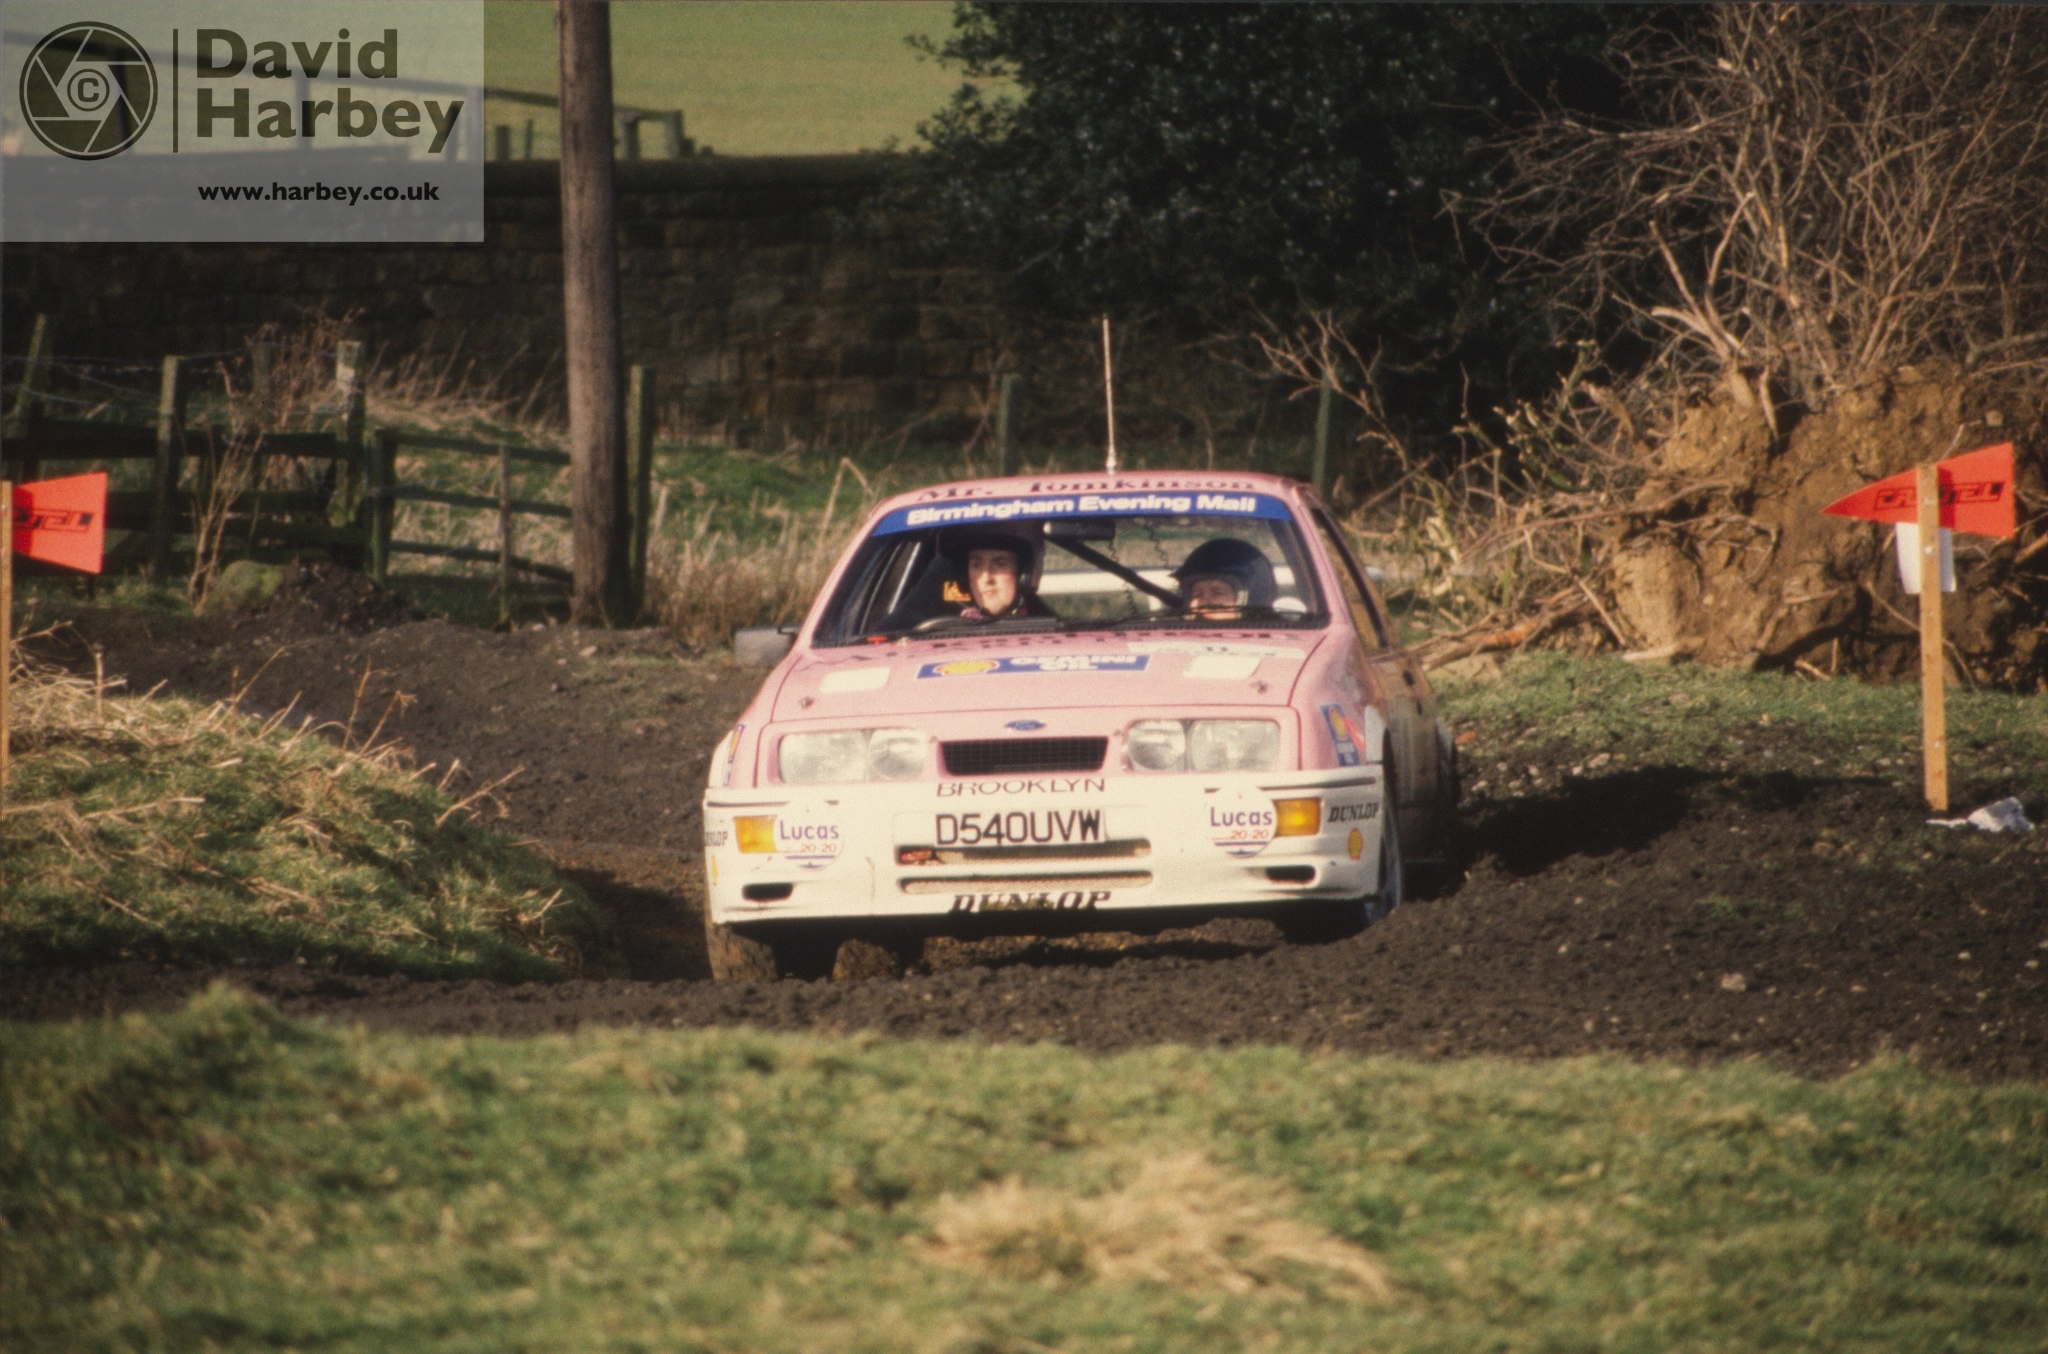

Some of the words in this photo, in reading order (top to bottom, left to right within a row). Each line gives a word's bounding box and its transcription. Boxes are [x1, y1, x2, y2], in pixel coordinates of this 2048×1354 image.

[1030, 480, 1255, 493] Tomkinson
[906, 498, 1075, 527] Birmingham
[1078, 494, 1192, 513] Evening
[1196, 494, 1257, 513] Mail
[936, 778, 1106, 797] BROOKLYN
[1209, 806, 1273, 828] Lucas
[1326, 802, 1380, 823] DUNLOP
[779, 819, 840, 841] Lucas
[935, 809, 1101, 846] D540UVW
[950, 890, 1112, 913] DUNLOP
